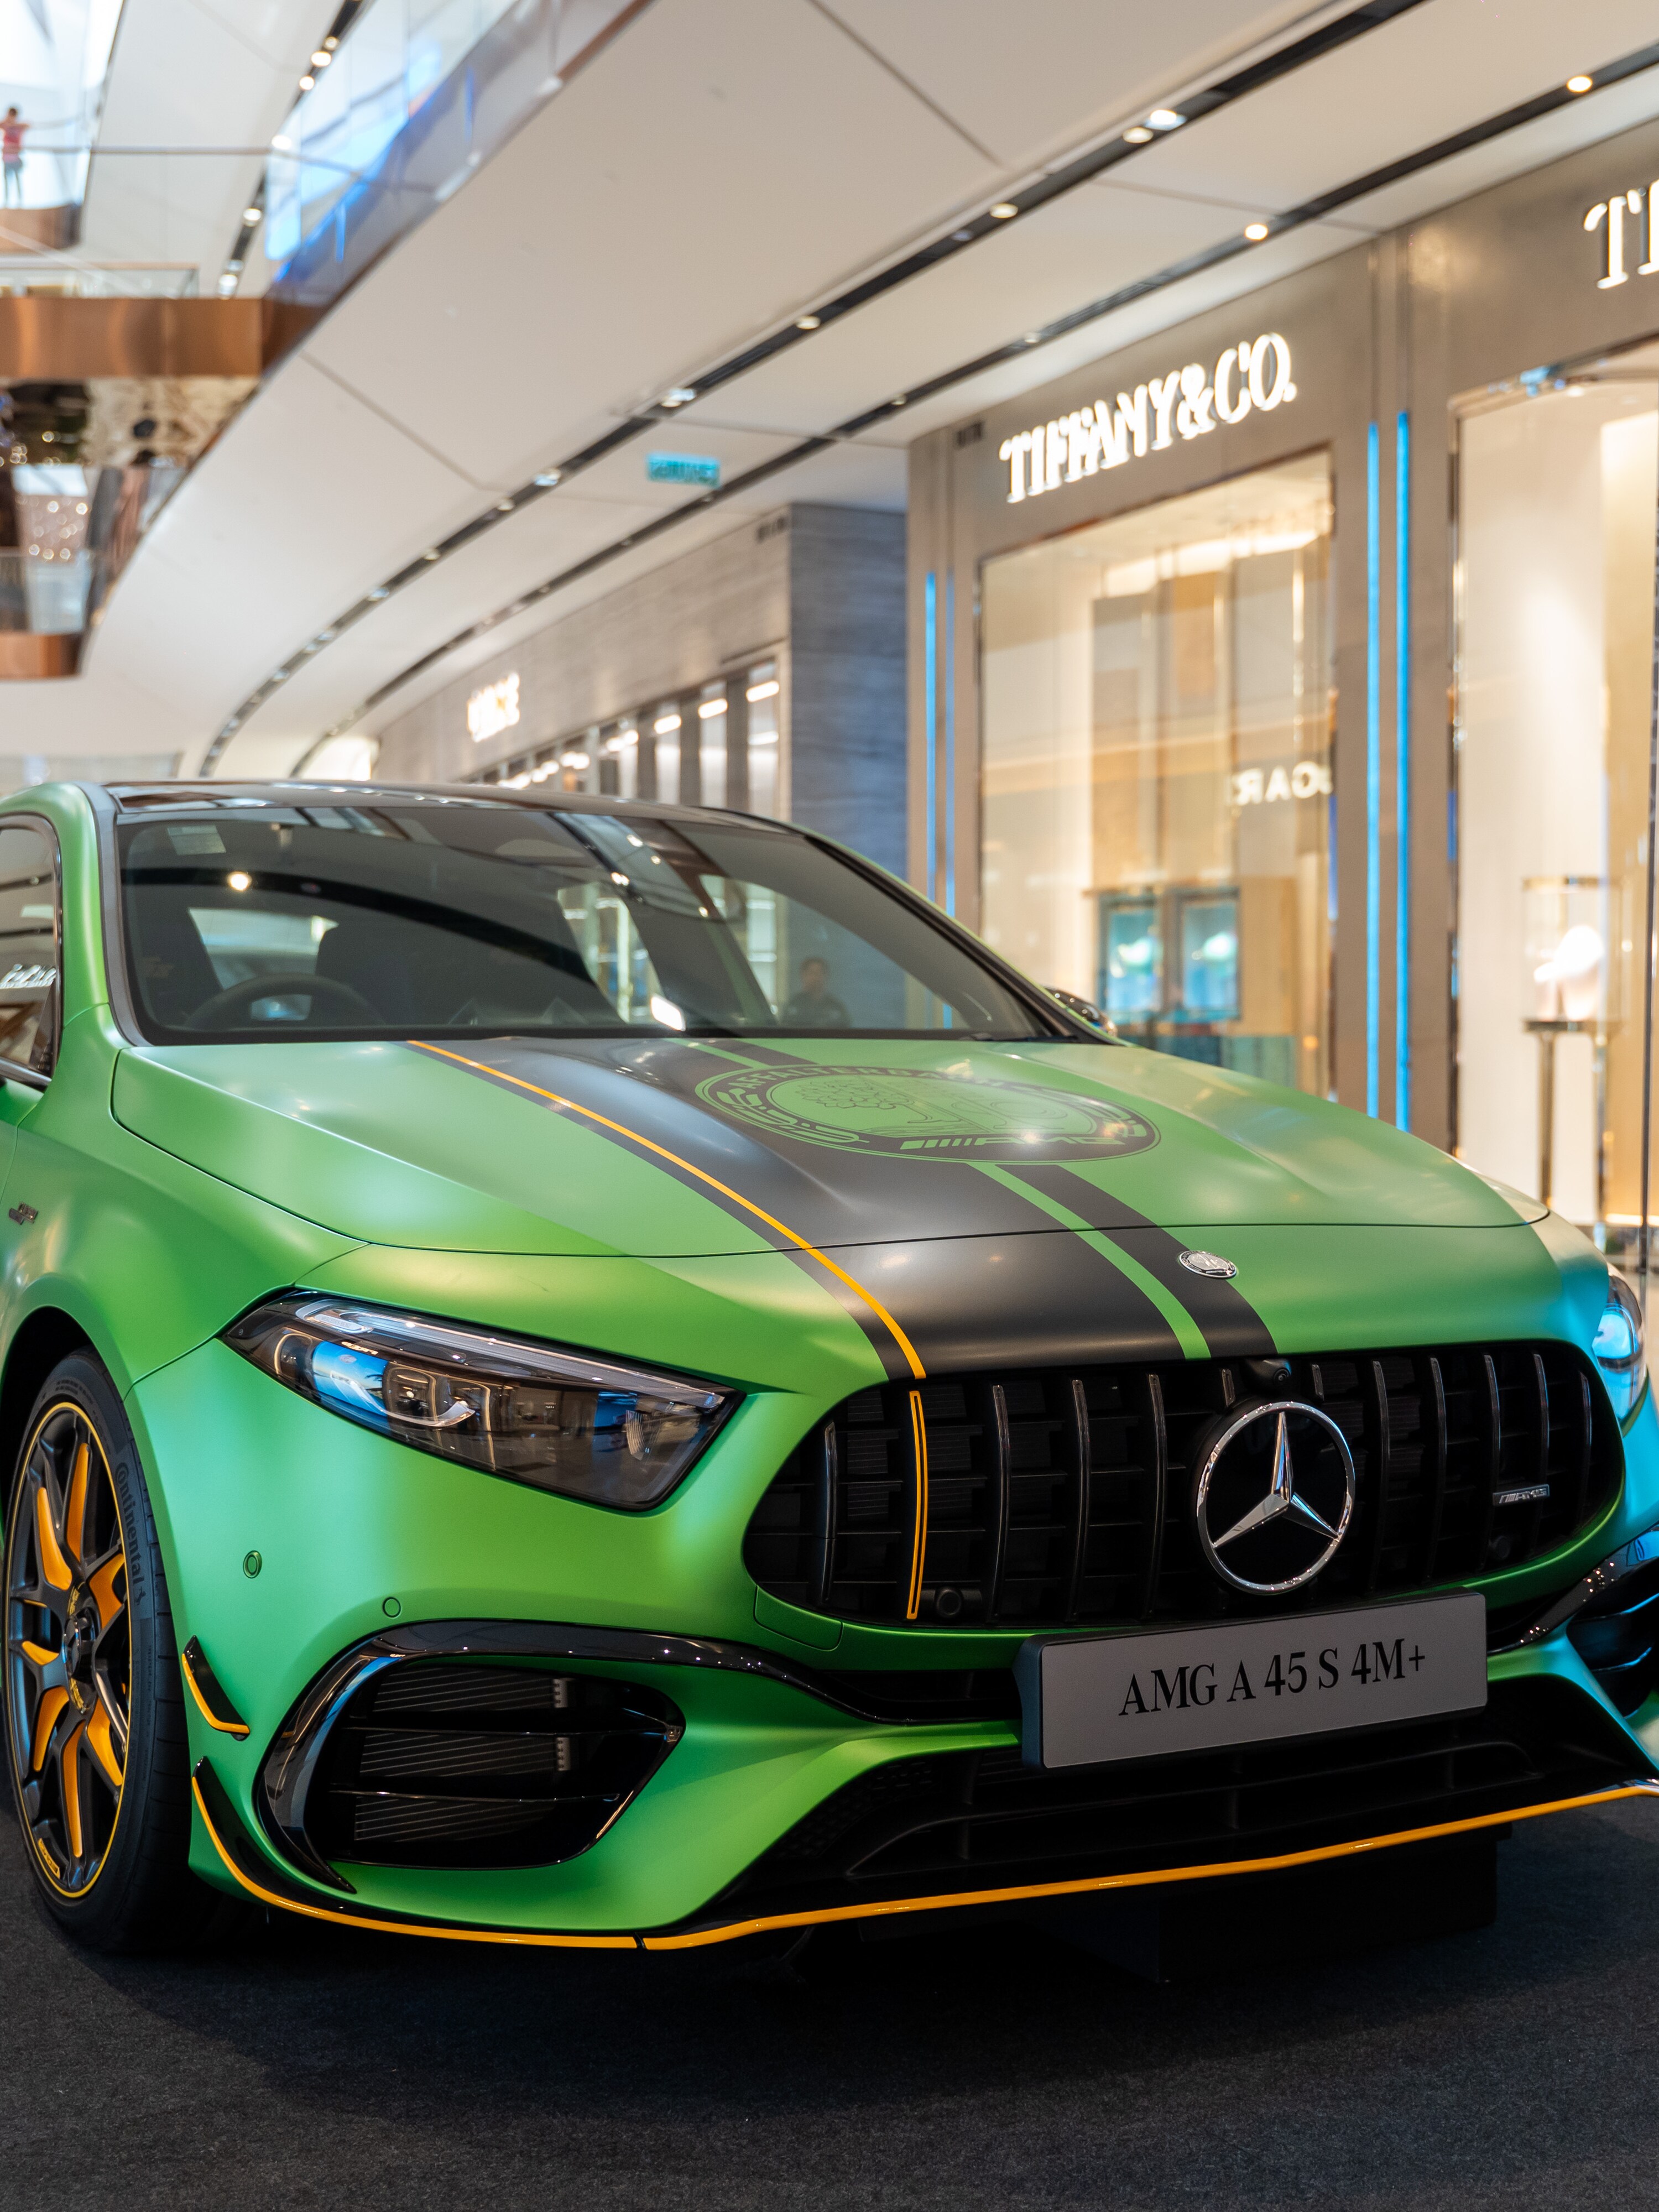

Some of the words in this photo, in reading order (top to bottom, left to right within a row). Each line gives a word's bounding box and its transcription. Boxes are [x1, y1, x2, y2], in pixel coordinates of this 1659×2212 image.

[114, 1462, 145, 1586] Continental
[1118, 1662, 1218, 1717] AMG
[1226, 1660, 1257, 1703] A
[1264, 1651, 1308, 1697] 45
[1318, 1647, 1339, 1691] S
[1351, 1637, 1426, 1684] 4M+
